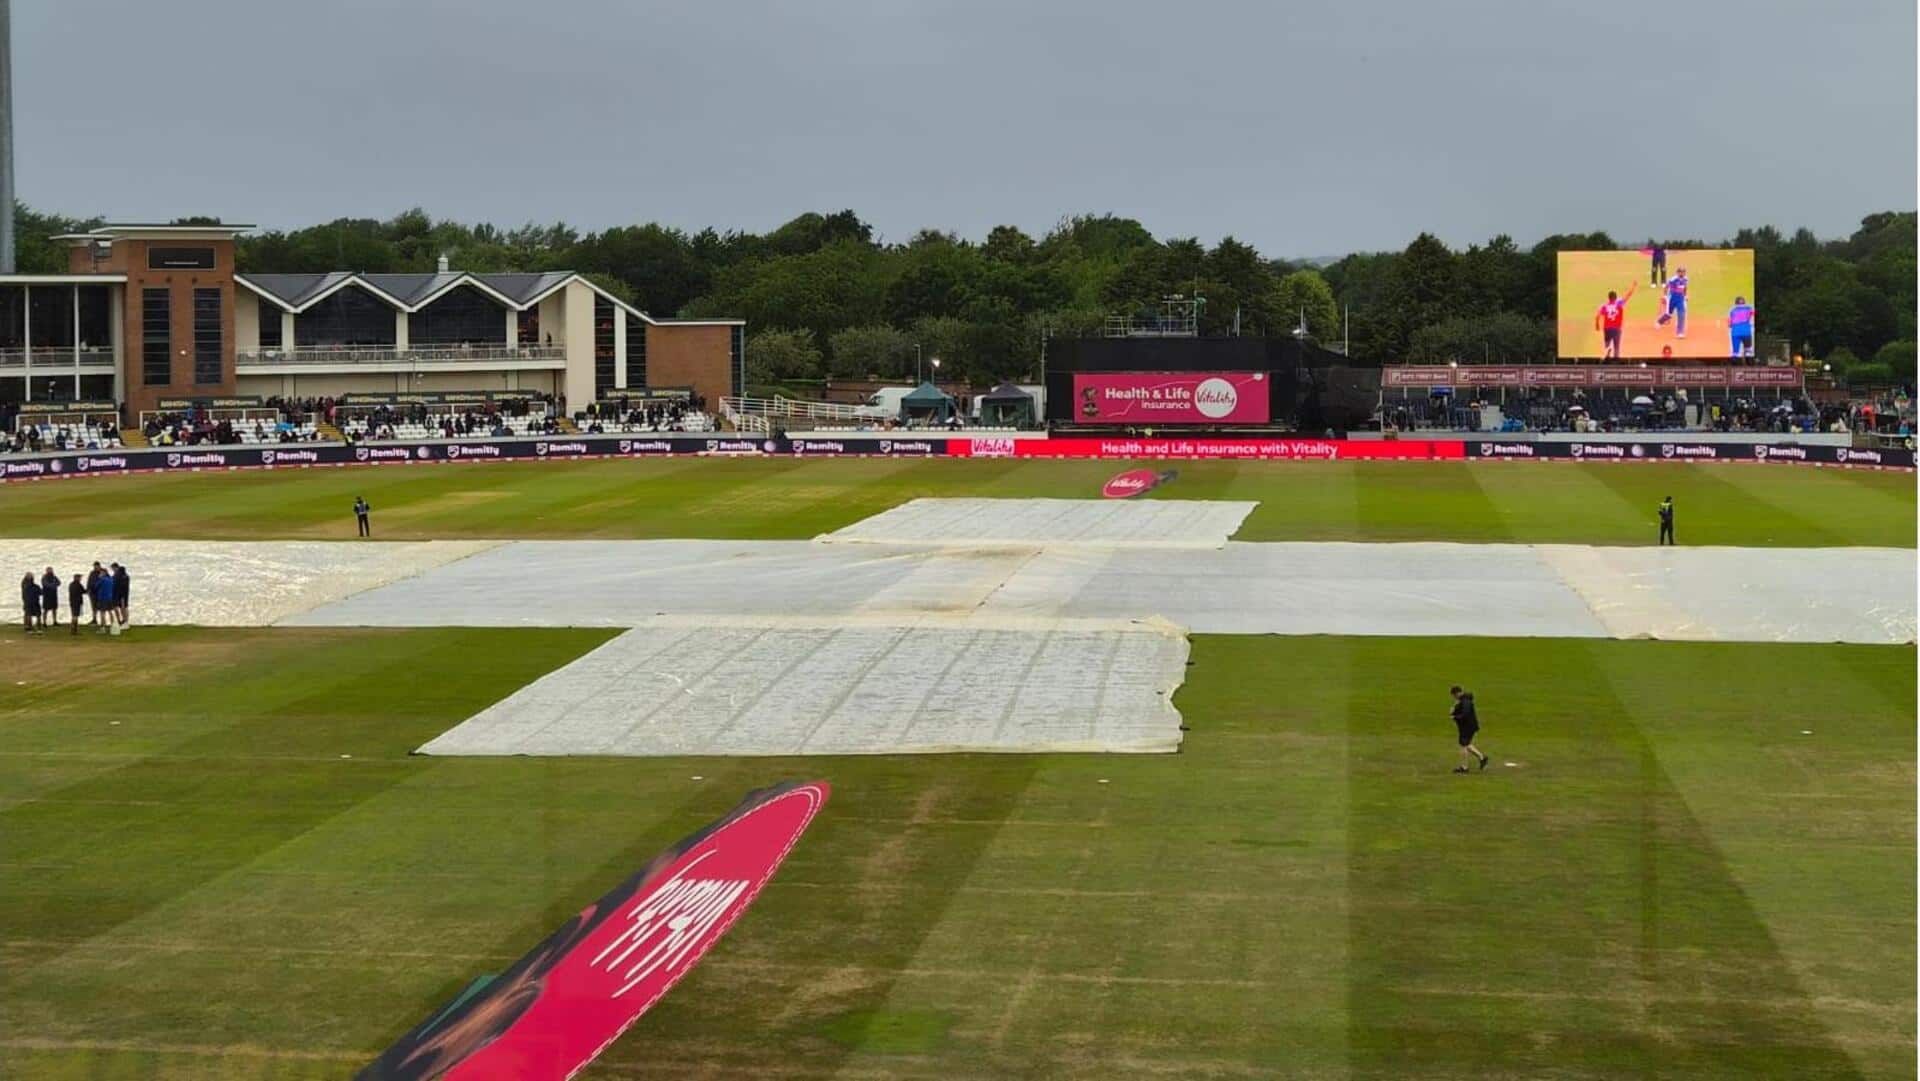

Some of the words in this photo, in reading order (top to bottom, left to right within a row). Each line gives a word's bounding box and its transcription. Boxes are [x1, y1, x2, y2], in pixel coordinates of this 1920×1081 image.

[1105, 387, 1149, 400] Health
[1152, 388, 1161, 399] &
[1165, 387, 1191, 400] Life
[1196, 388, 1236, 406] Vitality
[461, 445, 500, 456] Remitly
[550, 443, 587, 453] Remitly
[633, 440, 671, 452] Remitly
[720, 440, 757, 451] Remitly
[806, 441, 843, 452] Remitly
[893, 441, 931, 452] Remitly
[1102, 442, 1142, 453] Health
[1145, 442, 1169, 453] and
[1171, 442, 1194, 454] Life
[1260, 442, 1289, 454] with
[1291, 442, 1338, 455] Vitality
[1494, 444, 1533, 455] Remitly
[1585, 445, 1624, 456] Remitly
[1677, 446, 1716, 457] Remitly
[182, 453, 225, 465] Remitly
[276, 450, 318, 462] Remitly
[370, 448, 410, 459] Remitly
[1769, 447, 1806, 459] Remitly
[1849, 450, 1881, 463] Remitly
[7, 461, 44, 474] Remitly
[90, 457, 126, 469] Remitly
